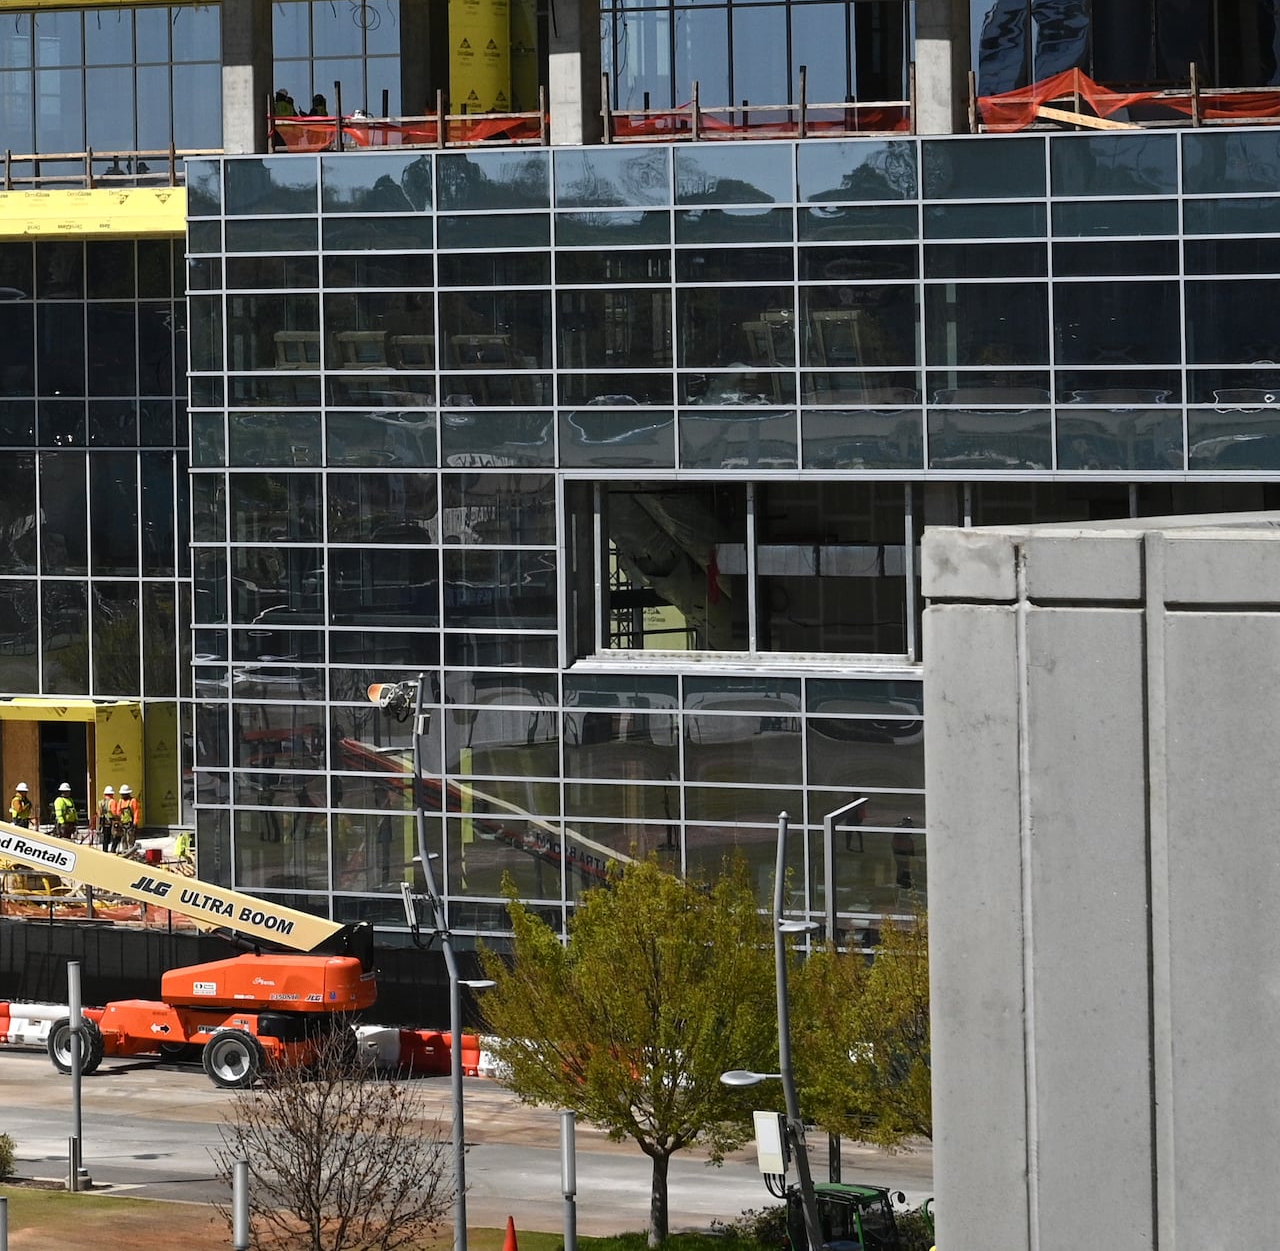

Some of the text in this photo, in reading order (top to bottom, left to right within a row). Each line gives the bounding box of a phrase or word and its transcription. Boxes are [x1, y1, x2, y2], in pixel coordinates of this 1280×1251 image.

[13, 840, 68, 866] Rentals
[130, 876, 295, 935] JLG ULTRA BOOM
